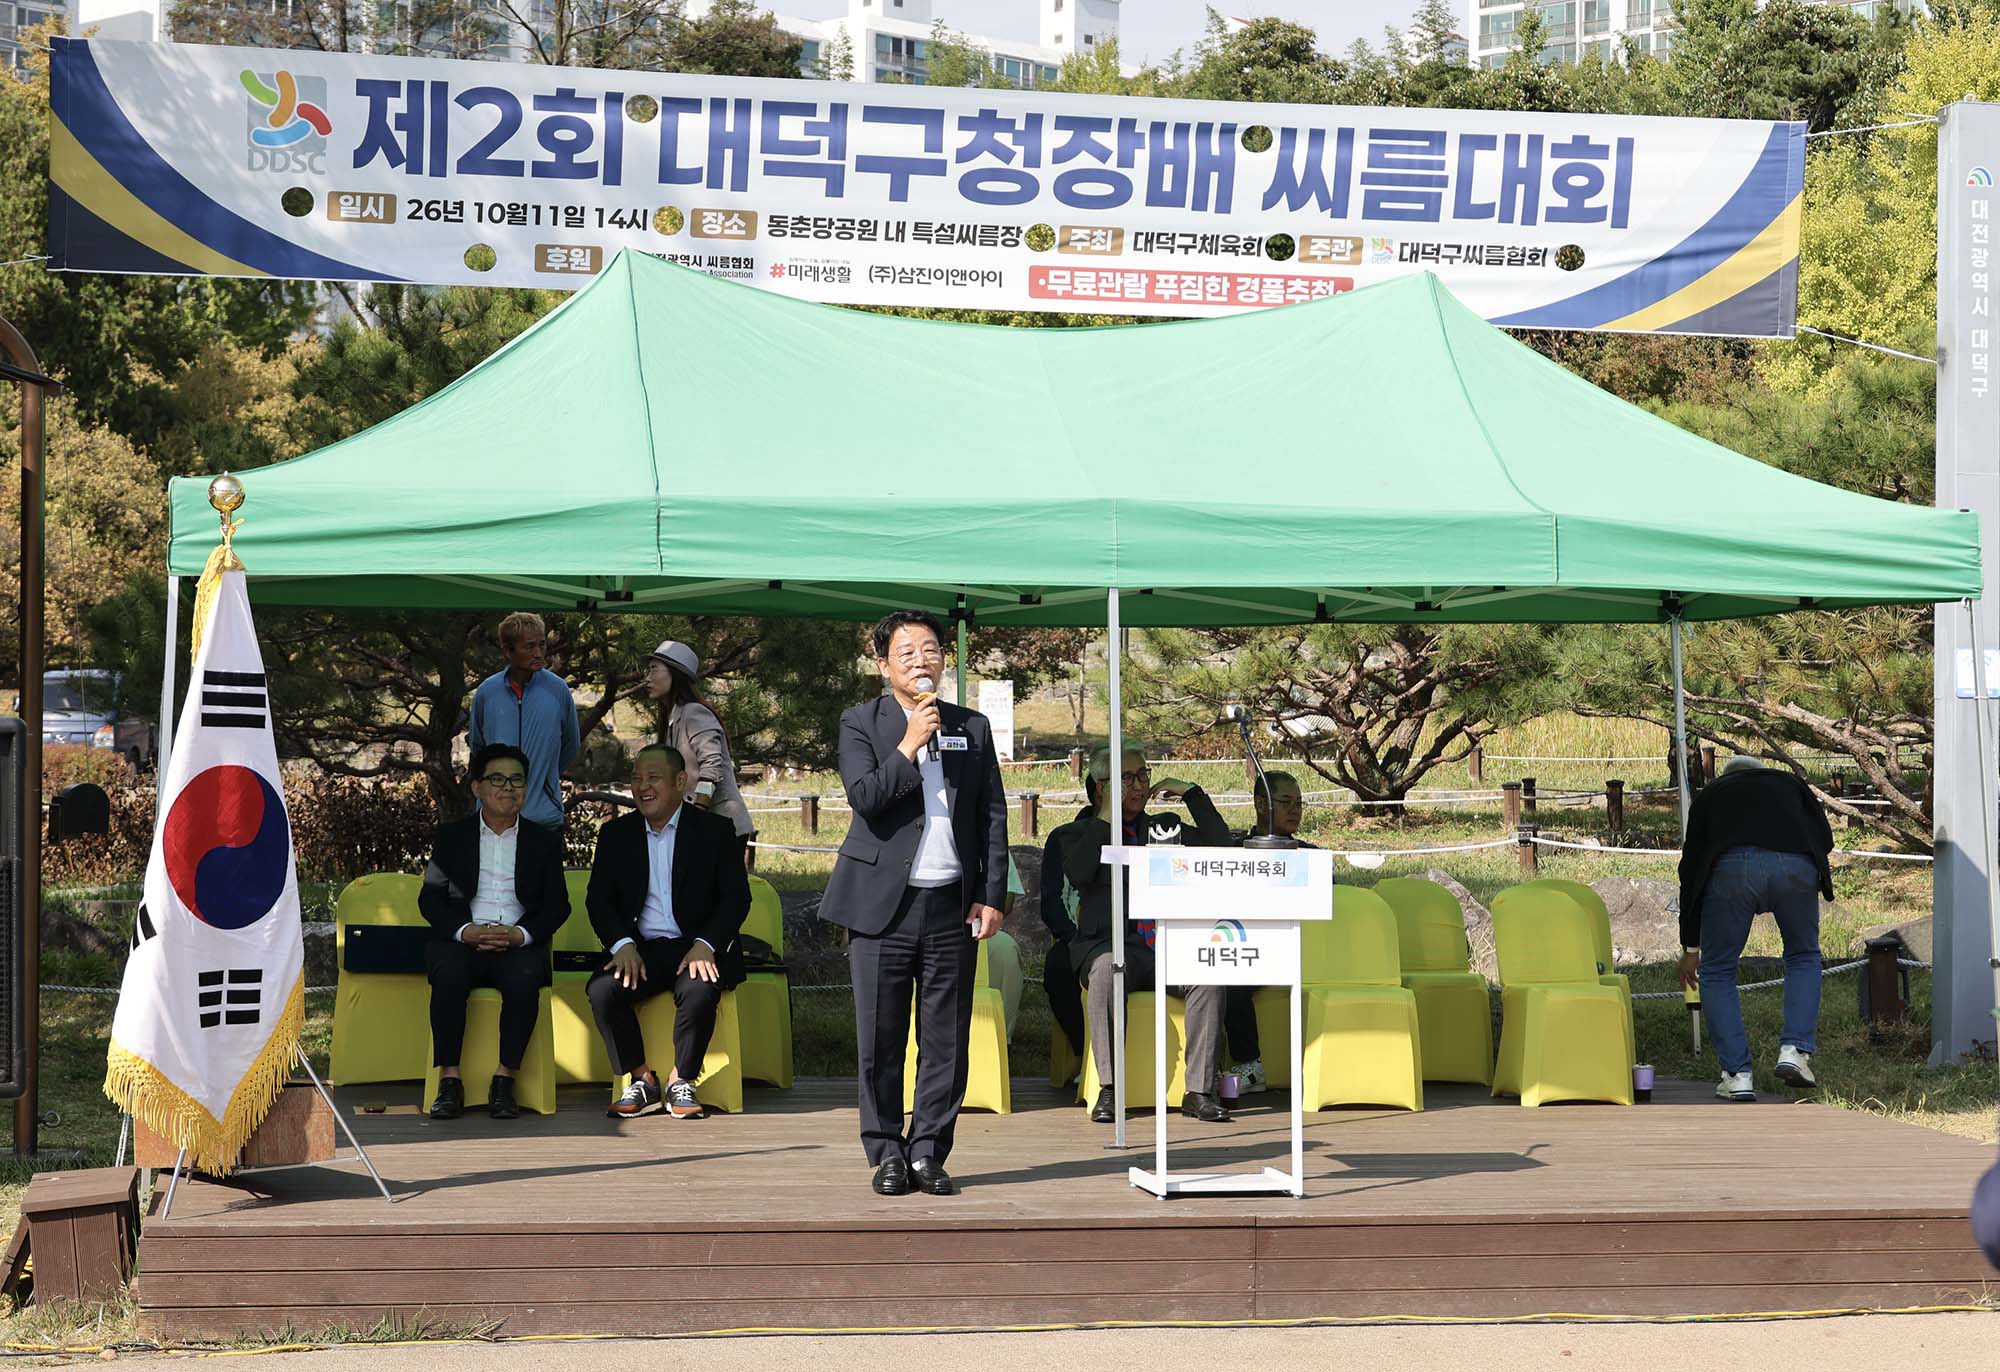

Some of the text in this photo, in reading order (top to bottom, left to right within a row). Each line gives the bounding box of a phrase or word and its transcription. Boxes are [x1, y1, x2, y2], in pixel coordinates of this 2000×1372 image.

[248, 149, 326, 175] DDSC
[353, 77, 1635, 229] 제2회 대덕구청장배 씨름대회
[338, 194, 385, 220] 일시
[407, 199, 464, 223] 26년
[594, 207, 648, 231] 14시
[701, 211, 1023, 248] 장소 동춘당공원 내 특설씨름장
[1069, 228, 1263, 257] 주최 대덕구체육회
[545, 246, 591, 272] 후원
[707, 255, 754, 270] 씨름협회
[1309, 237, 1548, 267] 주관 대덕구씨름협회
[868, 264, 1003, 288] (주)삼진이앤아이
[1154, 274, 1230, 302] 푸짐한
[1970, 200, 1989, 399] 대전광역시 대덕구
[1194, 859, 1286, 877] 대덕구체육회
[1198, 946, 1260, 967] 대덕구
